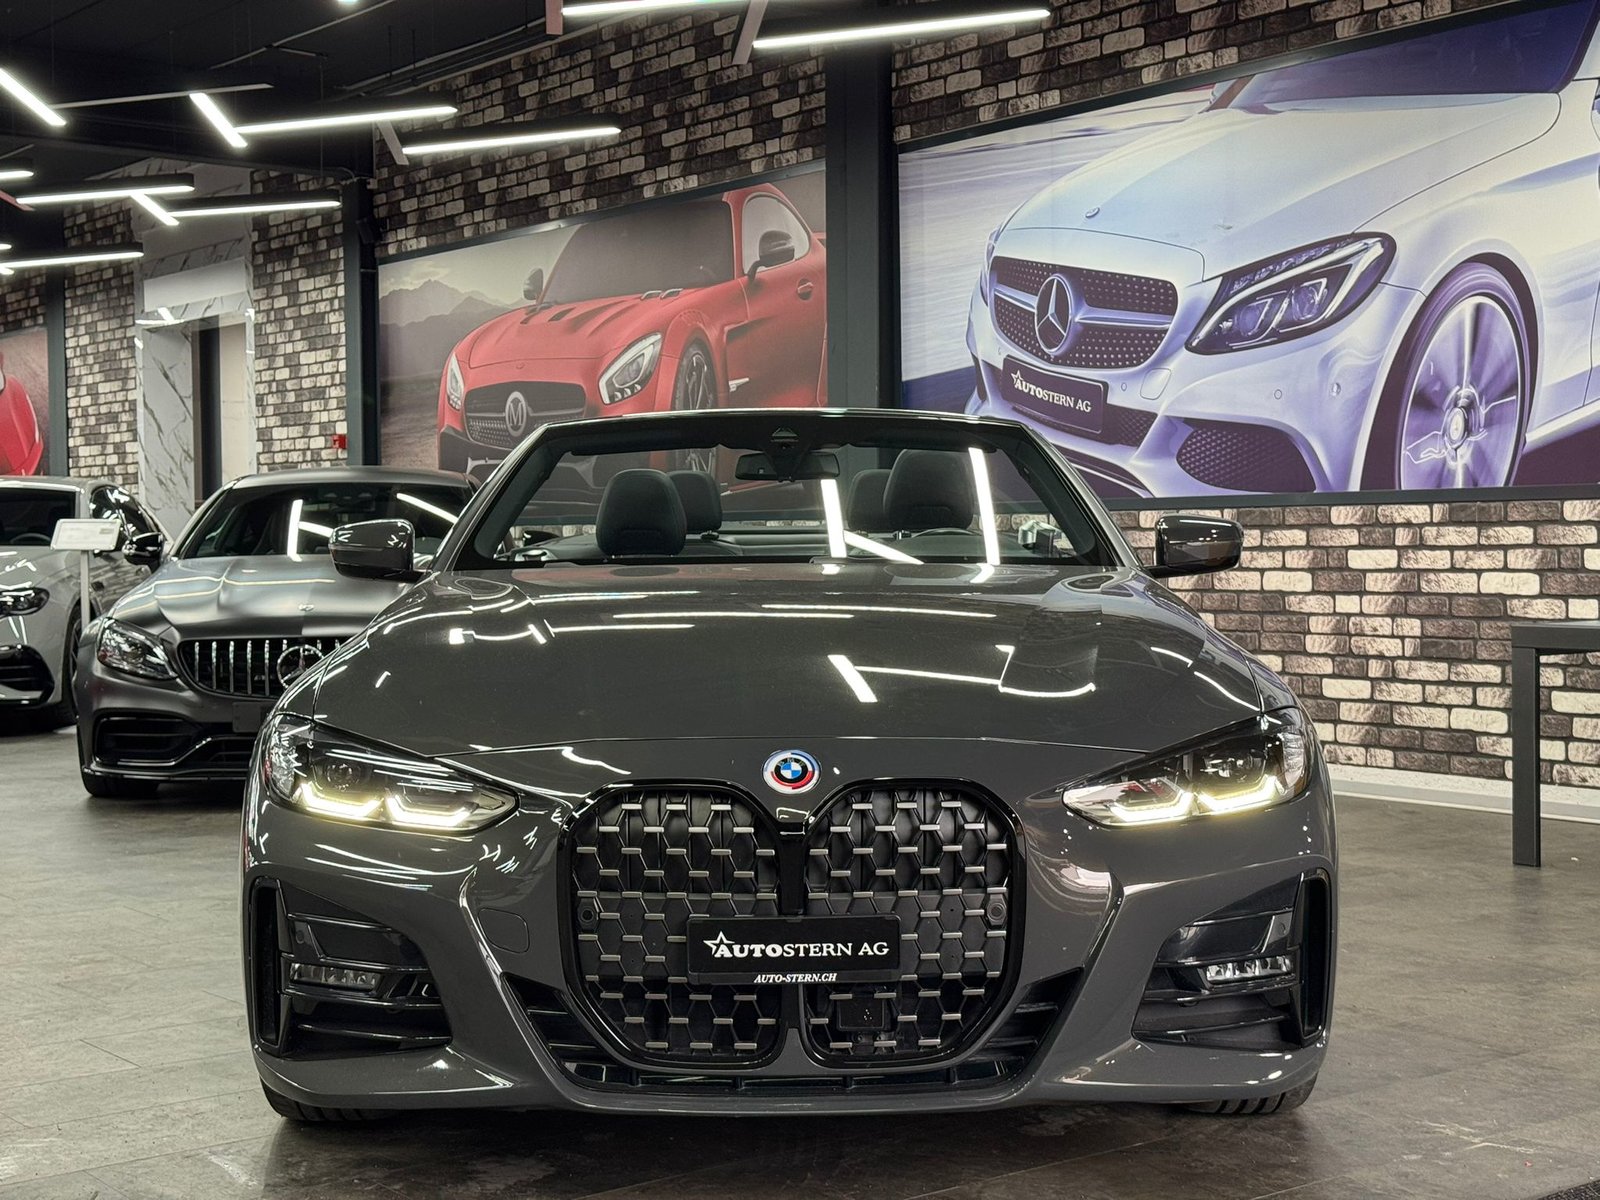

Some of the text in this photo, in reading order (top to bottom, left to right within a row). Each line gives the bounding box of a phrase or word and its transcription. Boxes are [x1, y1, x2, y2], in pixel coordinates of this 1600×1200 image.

[1014, 378, 1091, 412] AUTOSTERN AG
[714, 942, 890, 958] AUTOSTERN AG
[753, 972, 837, 983] AUTO-STERN.CH
